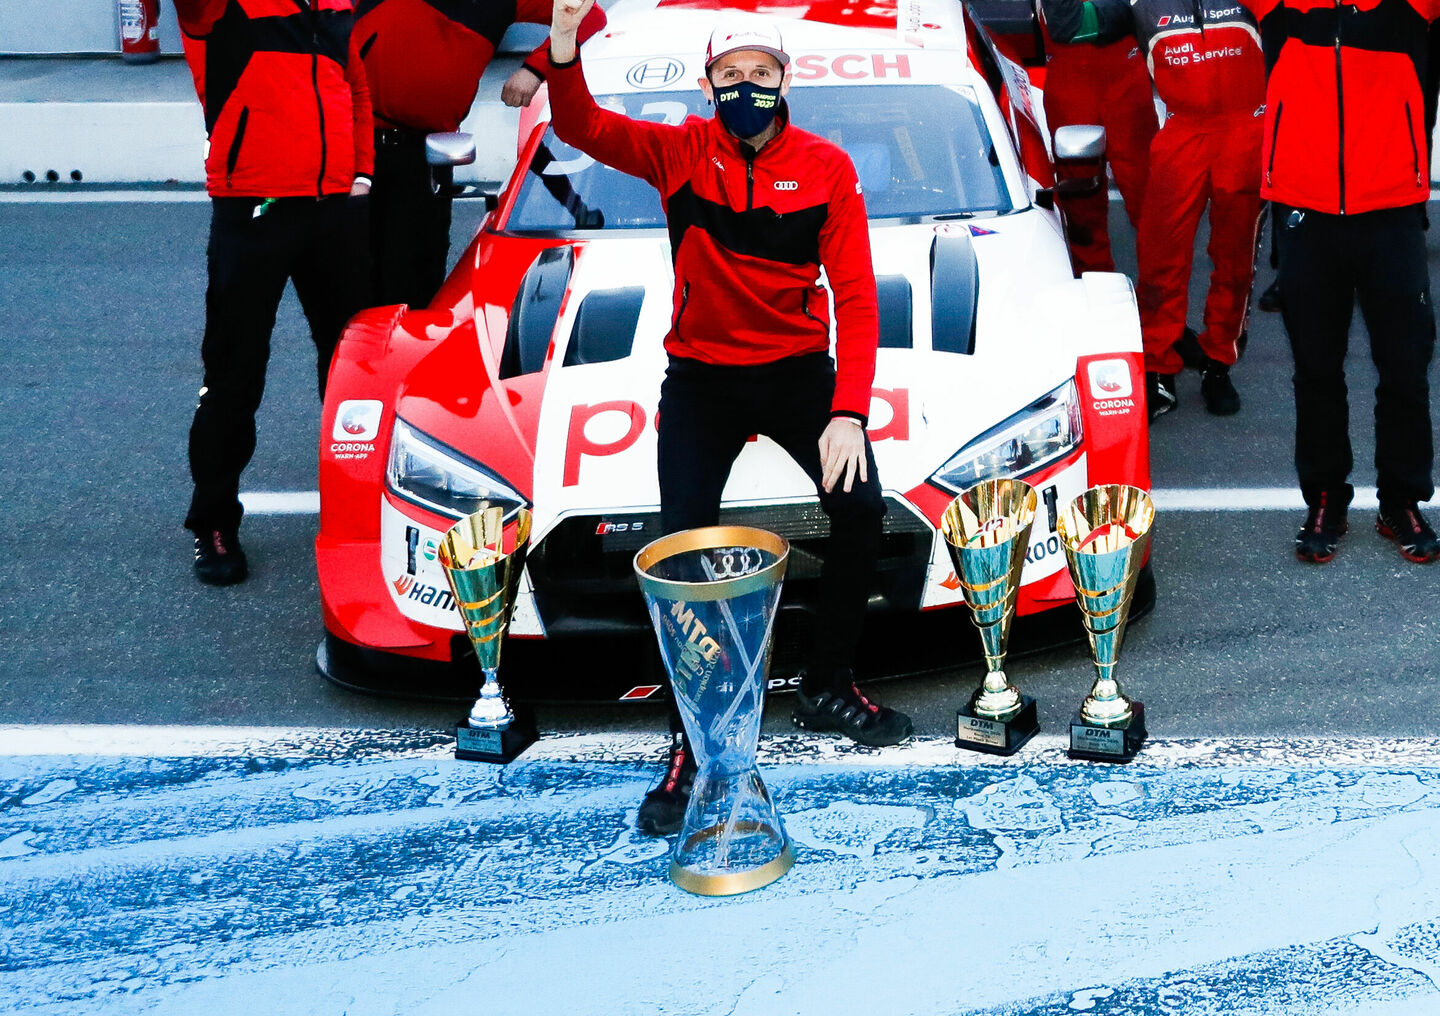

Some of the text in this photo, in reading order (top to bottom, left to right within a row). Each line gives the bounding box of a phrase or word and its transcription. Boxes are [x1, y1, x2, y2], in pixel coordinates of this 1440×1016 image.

[1209, 6, 1242, 19] Sport
[1164, 42, 1194, 55] Audi
[1164, 46, 1243, 66] Top Service
[785, 53, 912, 80] SCH
[720, 90, 740, 102] DTM
[1093, 399, 1135, 410] CORONA
[331, 443, 375, 452] CORONA
[631, 522, 644, 531] 5
[971, 718, 994, 730] DTM
[468, 730, 491, 739] DTM
[1085, 728, 1111, 738] DTM
